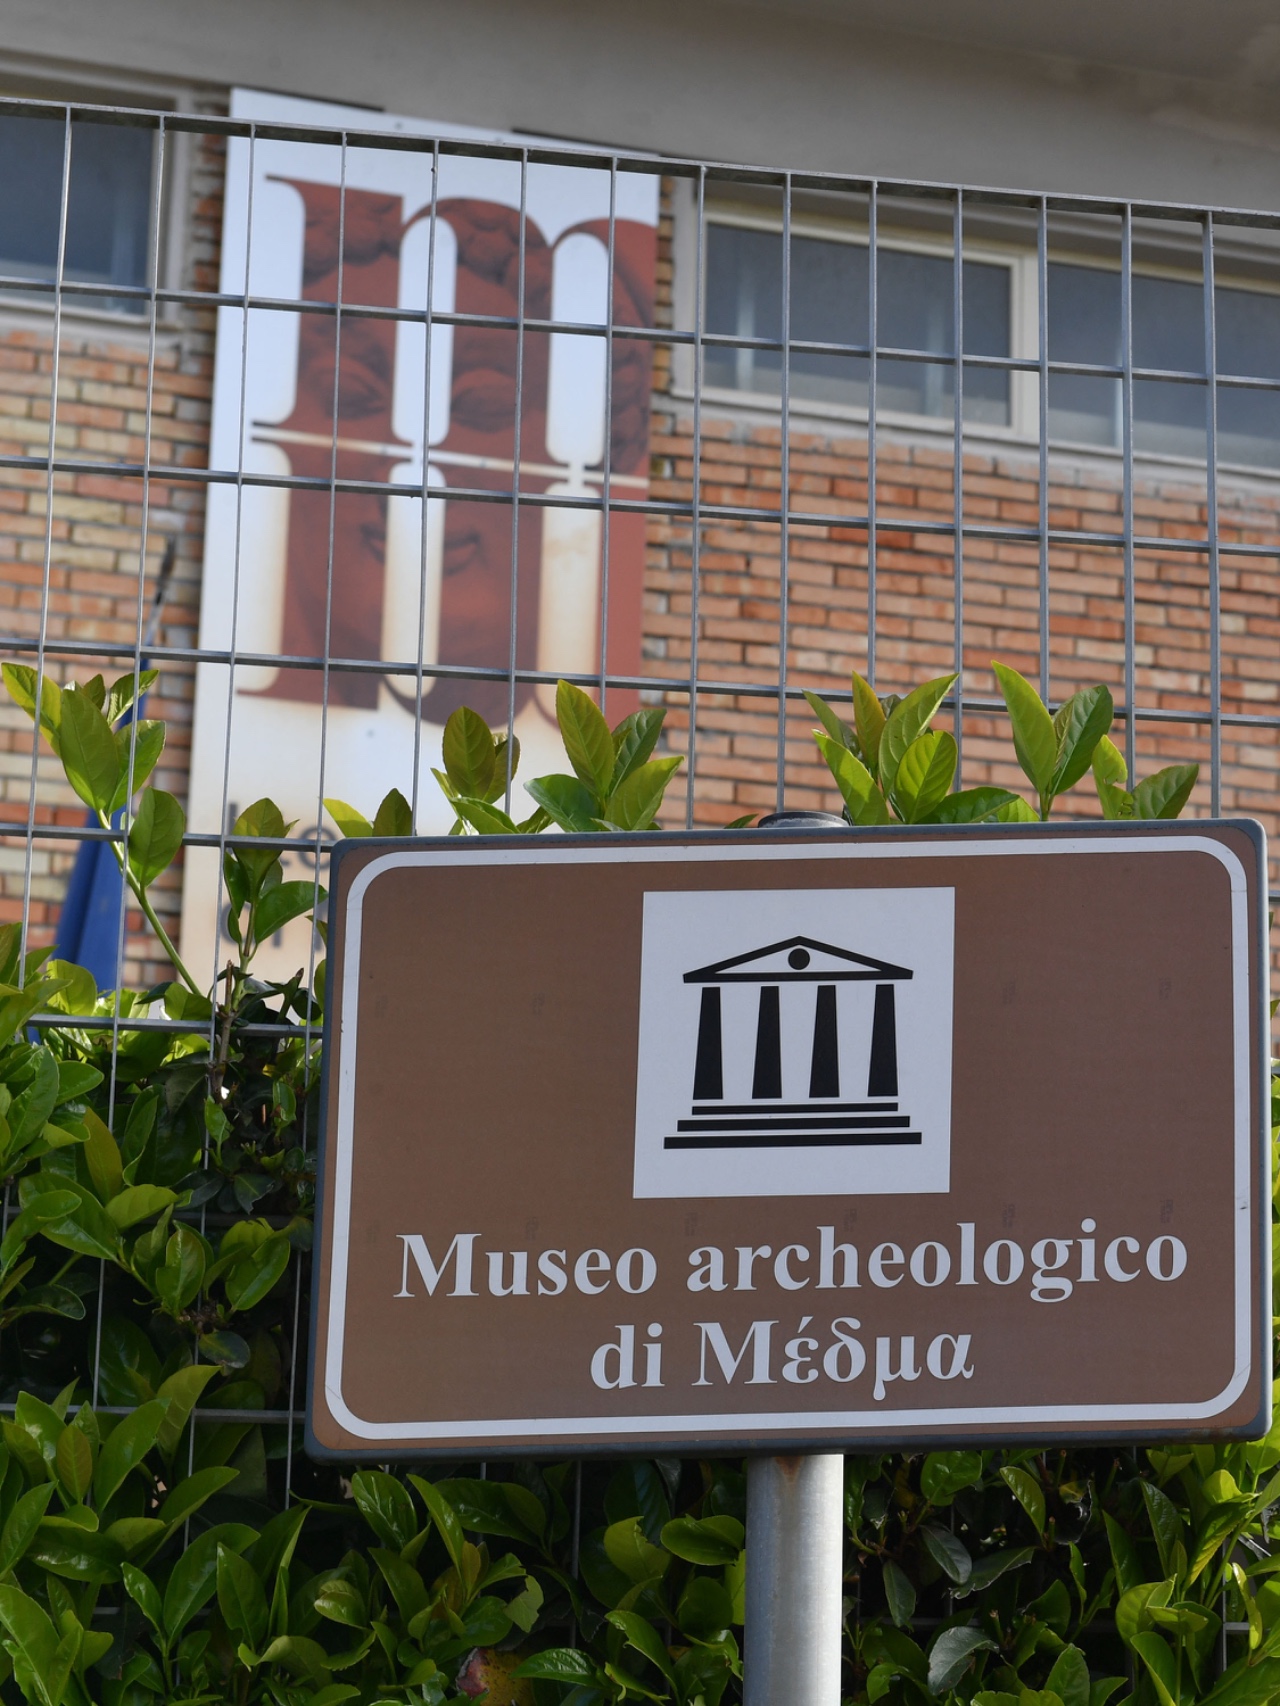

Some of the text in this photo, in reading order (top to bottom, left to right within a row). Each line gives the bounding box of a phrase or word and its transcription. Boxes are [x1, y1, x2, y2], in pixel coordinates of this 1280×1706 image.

[393, 1218, 1188, 1303] Museo archeologico
[590, 1322, 665, 1390] di
